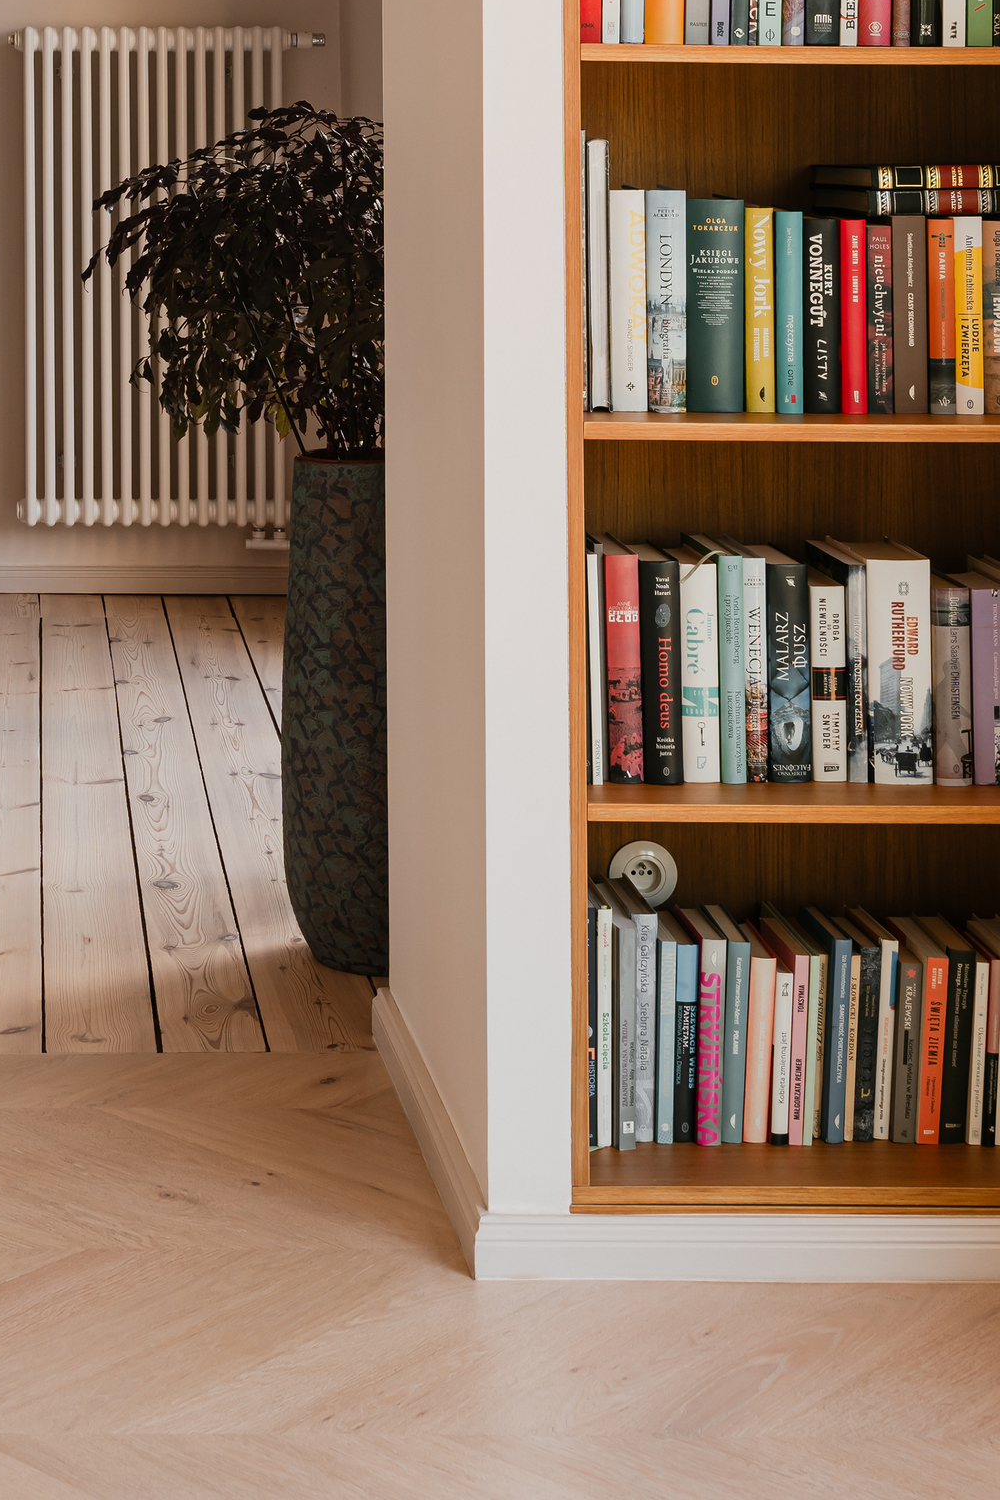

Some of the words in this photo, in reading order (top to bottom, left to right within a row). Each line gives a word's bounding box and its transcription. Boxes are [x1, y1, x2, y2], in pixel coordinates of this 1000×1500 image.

[693, 224, 738, 232] TOKARCZUK
[749, 214, 770, 271] Nowy
[629, 209, 647, 343] ADWOKAT
[659, 233, 674, 306] LONDYN
[690, 254, 739, 265] JAKUBOWE
[752, 275, 771, 318] Jork
[810, 233, 825, 327] VONNEGUT
[824, 263, 833, 296] KURT
[873, 255, 889, 336] nieuchwytni
[660, 318, 673, 360] Biografia
[971, 318, 980, 352] LUDZIE
[817, 338, 828, 380] LISTY
[733, 594, 741, 616] Anda
[686, 608, 706, 675] Cabré
[706, 612, 715, 642] Jaume
[731, 617, 741, 664] Rottenberg
[819, 598, 829, 657] NIEWOLNOŚCI
[891, 601, 906, 671] RUTHERFURD
[906, 616, 919, 655] EDWARD
[658, 637, 672, 688] Homo
[775, 611, 789, 681] MALARZ
[659, 692, 674, 729] deus
[900, 676, 914, 709] NOWY
[822, 714, 831, 749] SNYDER
[832, 711, 840, 751] TIMOTHY
[900, 710, 913, 737] JORK
[797, 984, 805, 1013] TOKSYMIA
[929, 1001, 942, 1032] ŚWIĘTA
[601, 1012, 610, 1043] Szkoła
[689, 1004, 698, 1054] SZEWACH
[780, 1032, 788, 1045] jest
[976, 1026, 985, 1058] Ukochane
[600, 1044, 610, 1070] cięcia
[697, 971, 723, 1146] STRYJEŃSKA
[927, 1036, 940, 1066] ZIEMIA
[687, 1057, 696, 1089] WEISS
[793, 1082, 801, 1120] MAŁGORZATA
[973, 1089, 981, 1118] profesora
